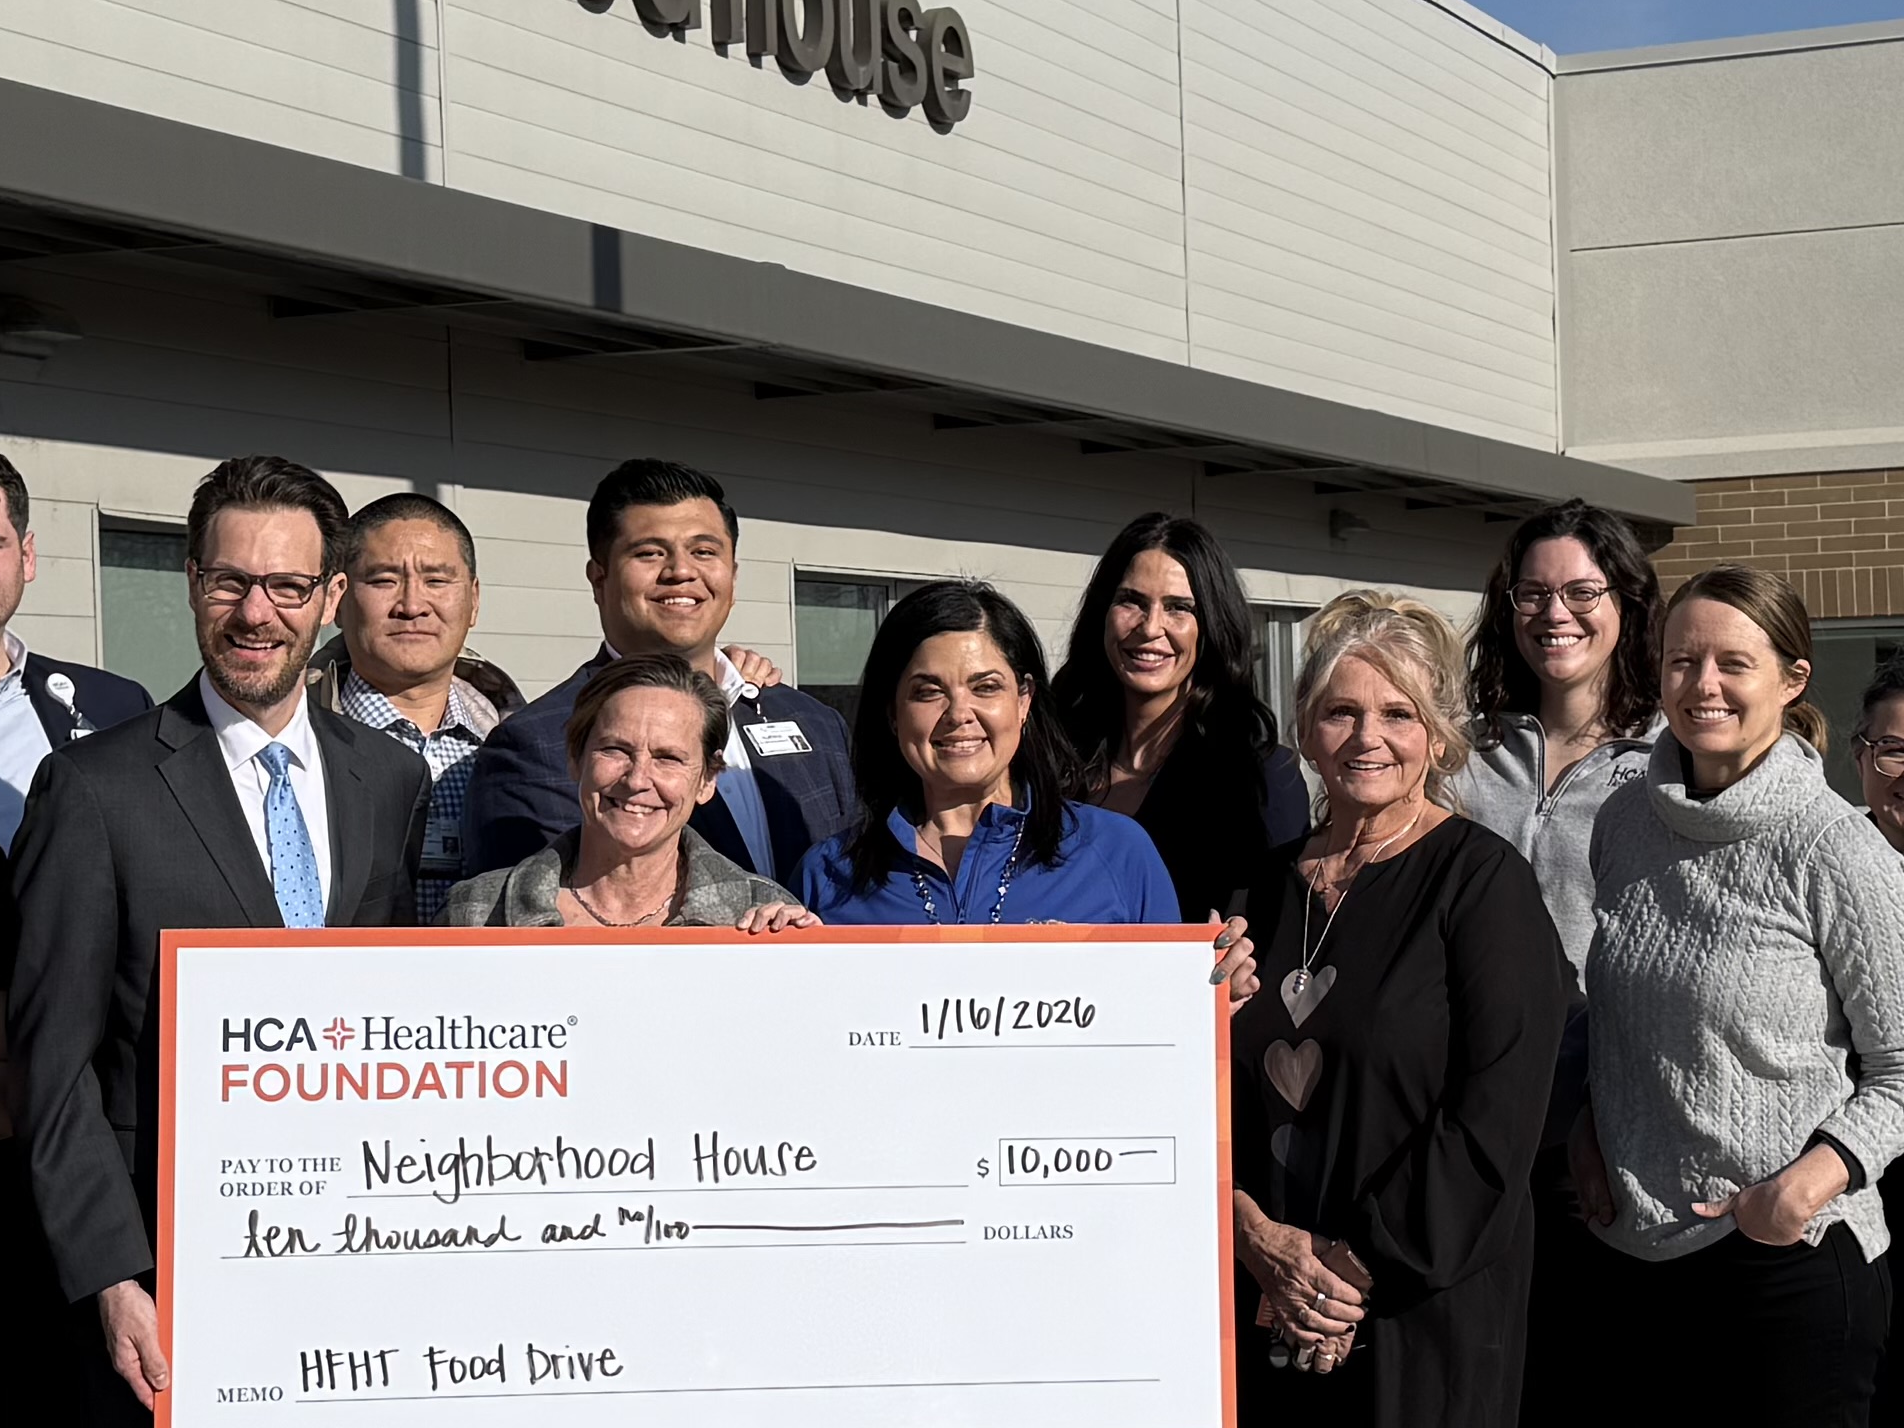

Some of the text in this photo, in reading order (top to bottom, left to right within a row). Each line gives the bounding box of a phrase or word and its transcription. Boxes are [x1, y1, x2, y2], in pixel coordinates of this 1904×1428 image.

[921, 996, 1096, 1040] 1/16/2026
[222, 1017, 318, 1053] HCA
[848, 1031, 902, 1047] DATE
[221, 1059, 568, 1103] FOUNDATION
[220, 1157, 342, 1174] PAY TO THE
[362, 1130, 817, 1205] Neighborhood House
[976, 1157, 990, 1179] $
[219, 1180, 327, 1197] ORDER OF
[243, 1209, 322, 1258] ten
[332, 1213, 522, 1255] thousand
[540, 1213, 607, 1245] and
[983, 1225, 1075, 1240] DOLLARS
[422, 1342, 507, 1392] Food
[526, 1342, 624, 1386] Drive
[216, 1386, 285, 1403] MEMO
